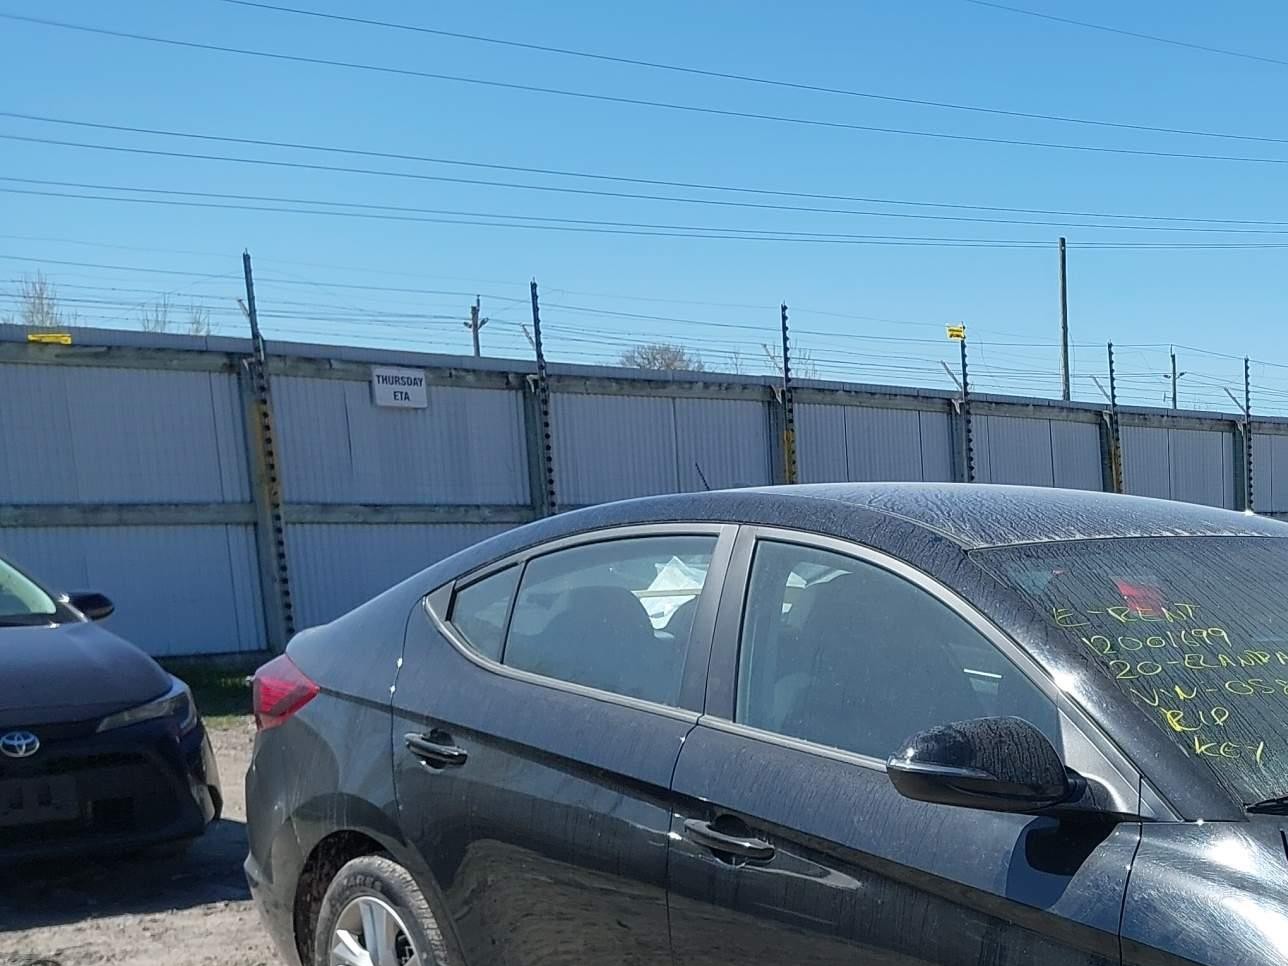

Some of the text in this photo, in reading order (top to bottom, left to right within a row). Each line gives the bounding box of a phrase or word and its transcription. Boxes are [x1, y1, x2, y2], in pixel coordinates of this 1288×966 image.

[376, 374, 424, 388] THURSDAY
[393, 391, 411, 402] ETA
[1082, 627, 1233, 657] 12001699
